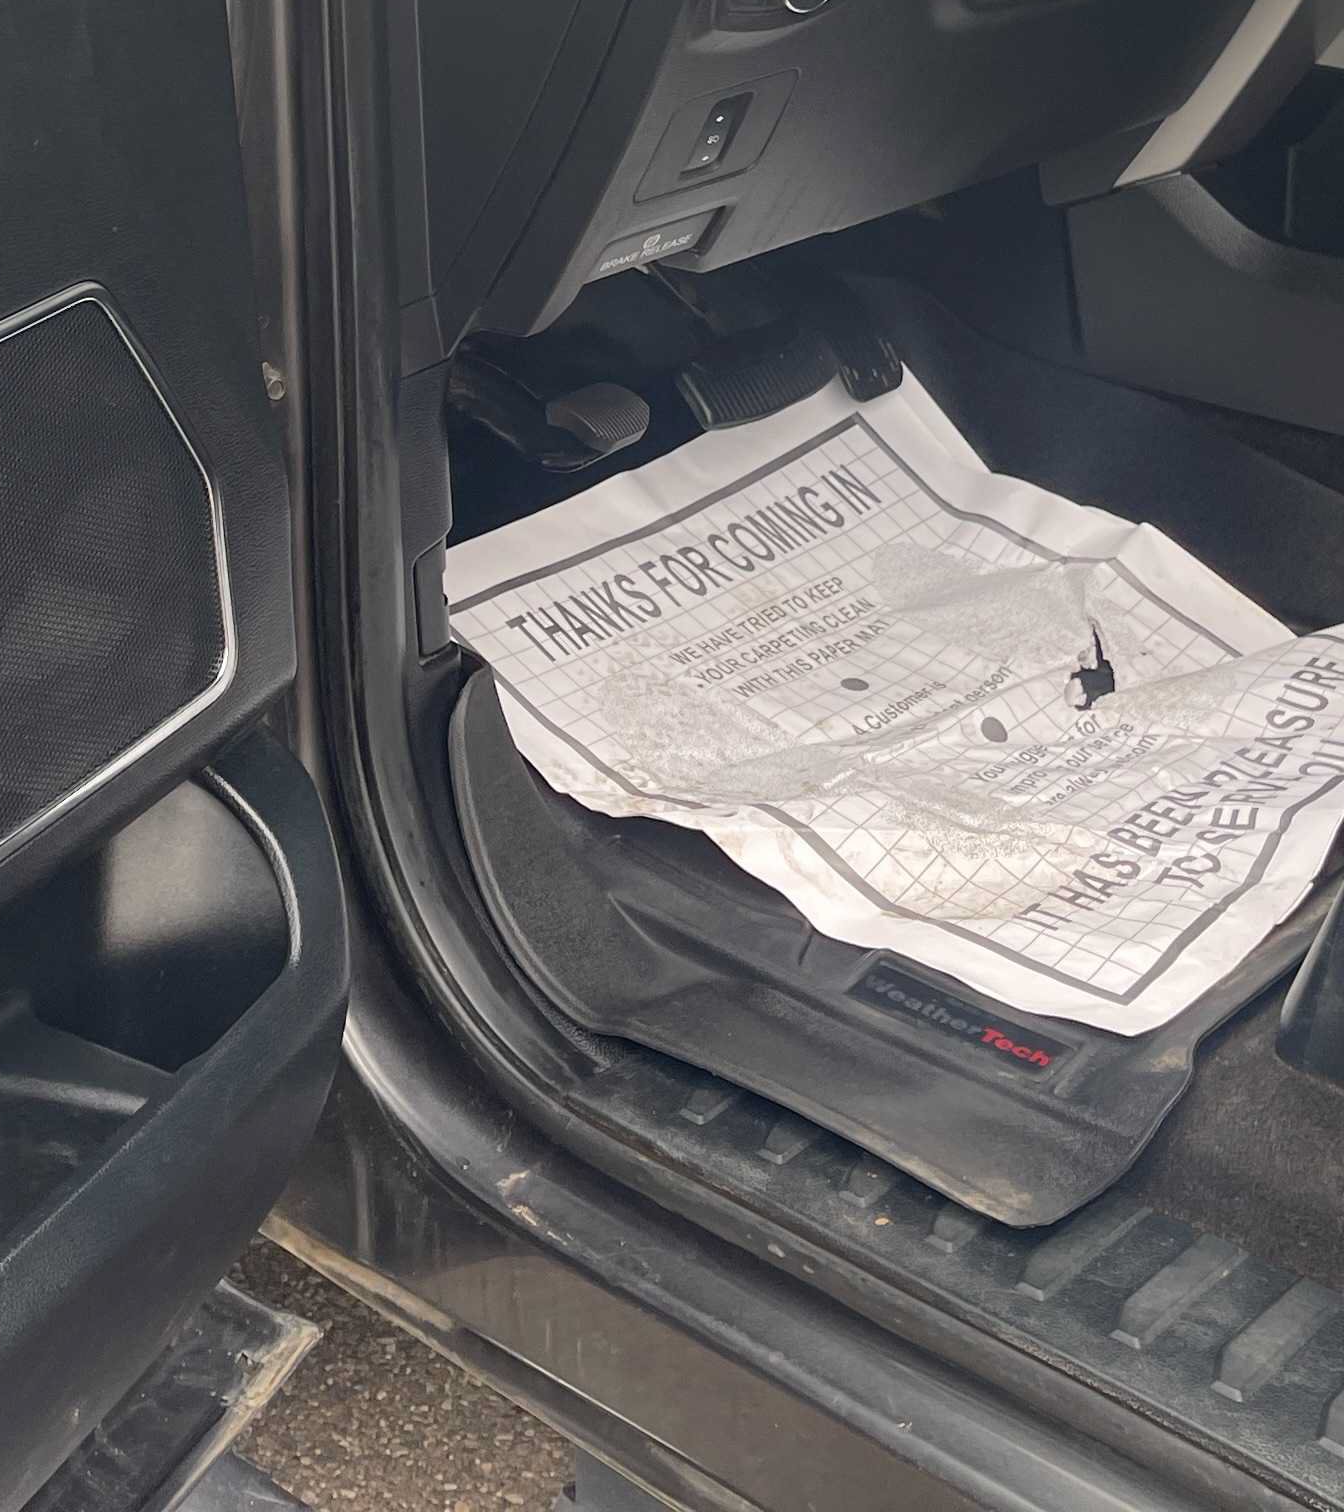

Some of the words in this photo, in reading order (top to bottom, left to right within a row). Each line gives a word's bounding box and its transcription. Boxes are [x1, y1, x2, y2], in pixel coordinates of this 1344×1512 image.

[599, 250, 641, 272] BRAKE
[640, 233, 694, 258] RELEASE
[506, 574, 662, 663] THANKS
[638, 546, 734, 608] FOR
[706, 486, 845, 573] COMING
[821, 463, 883, 516] IN
[668, 646, 703, 666] WE
[702, 627, 745, 655] HAVE
[737, 604, 788, 636] TRIED
[782, 595, 809, 614] TO
[807, 576, 844, 604] KEEP
[694, 657, 746, 685] YOUR
[741, 620, 827, 665] CARPETING
[822, 596, 876, 629] CLEAN
[732, 672, 781, 700] WITH
[772, 657, 814, 685] THIS
[810, 637, 860, 665] PAPER
[853, 618, 892, 645] MAT
[964, 664, 1014, 704] person
[863, 685, 934, 730] Customer
[1074, 713, 1102, 737] for
[1065, 744, 1093, 768] our
[1011, 902, 1073, 931] IT
[1047, 852, 1142, 912] HAS
[1107, 788, 1211, 859] BEEN
[1154, 851, 1222, 890] TO
[864, 974, 1052, 1068] WeatherTech
